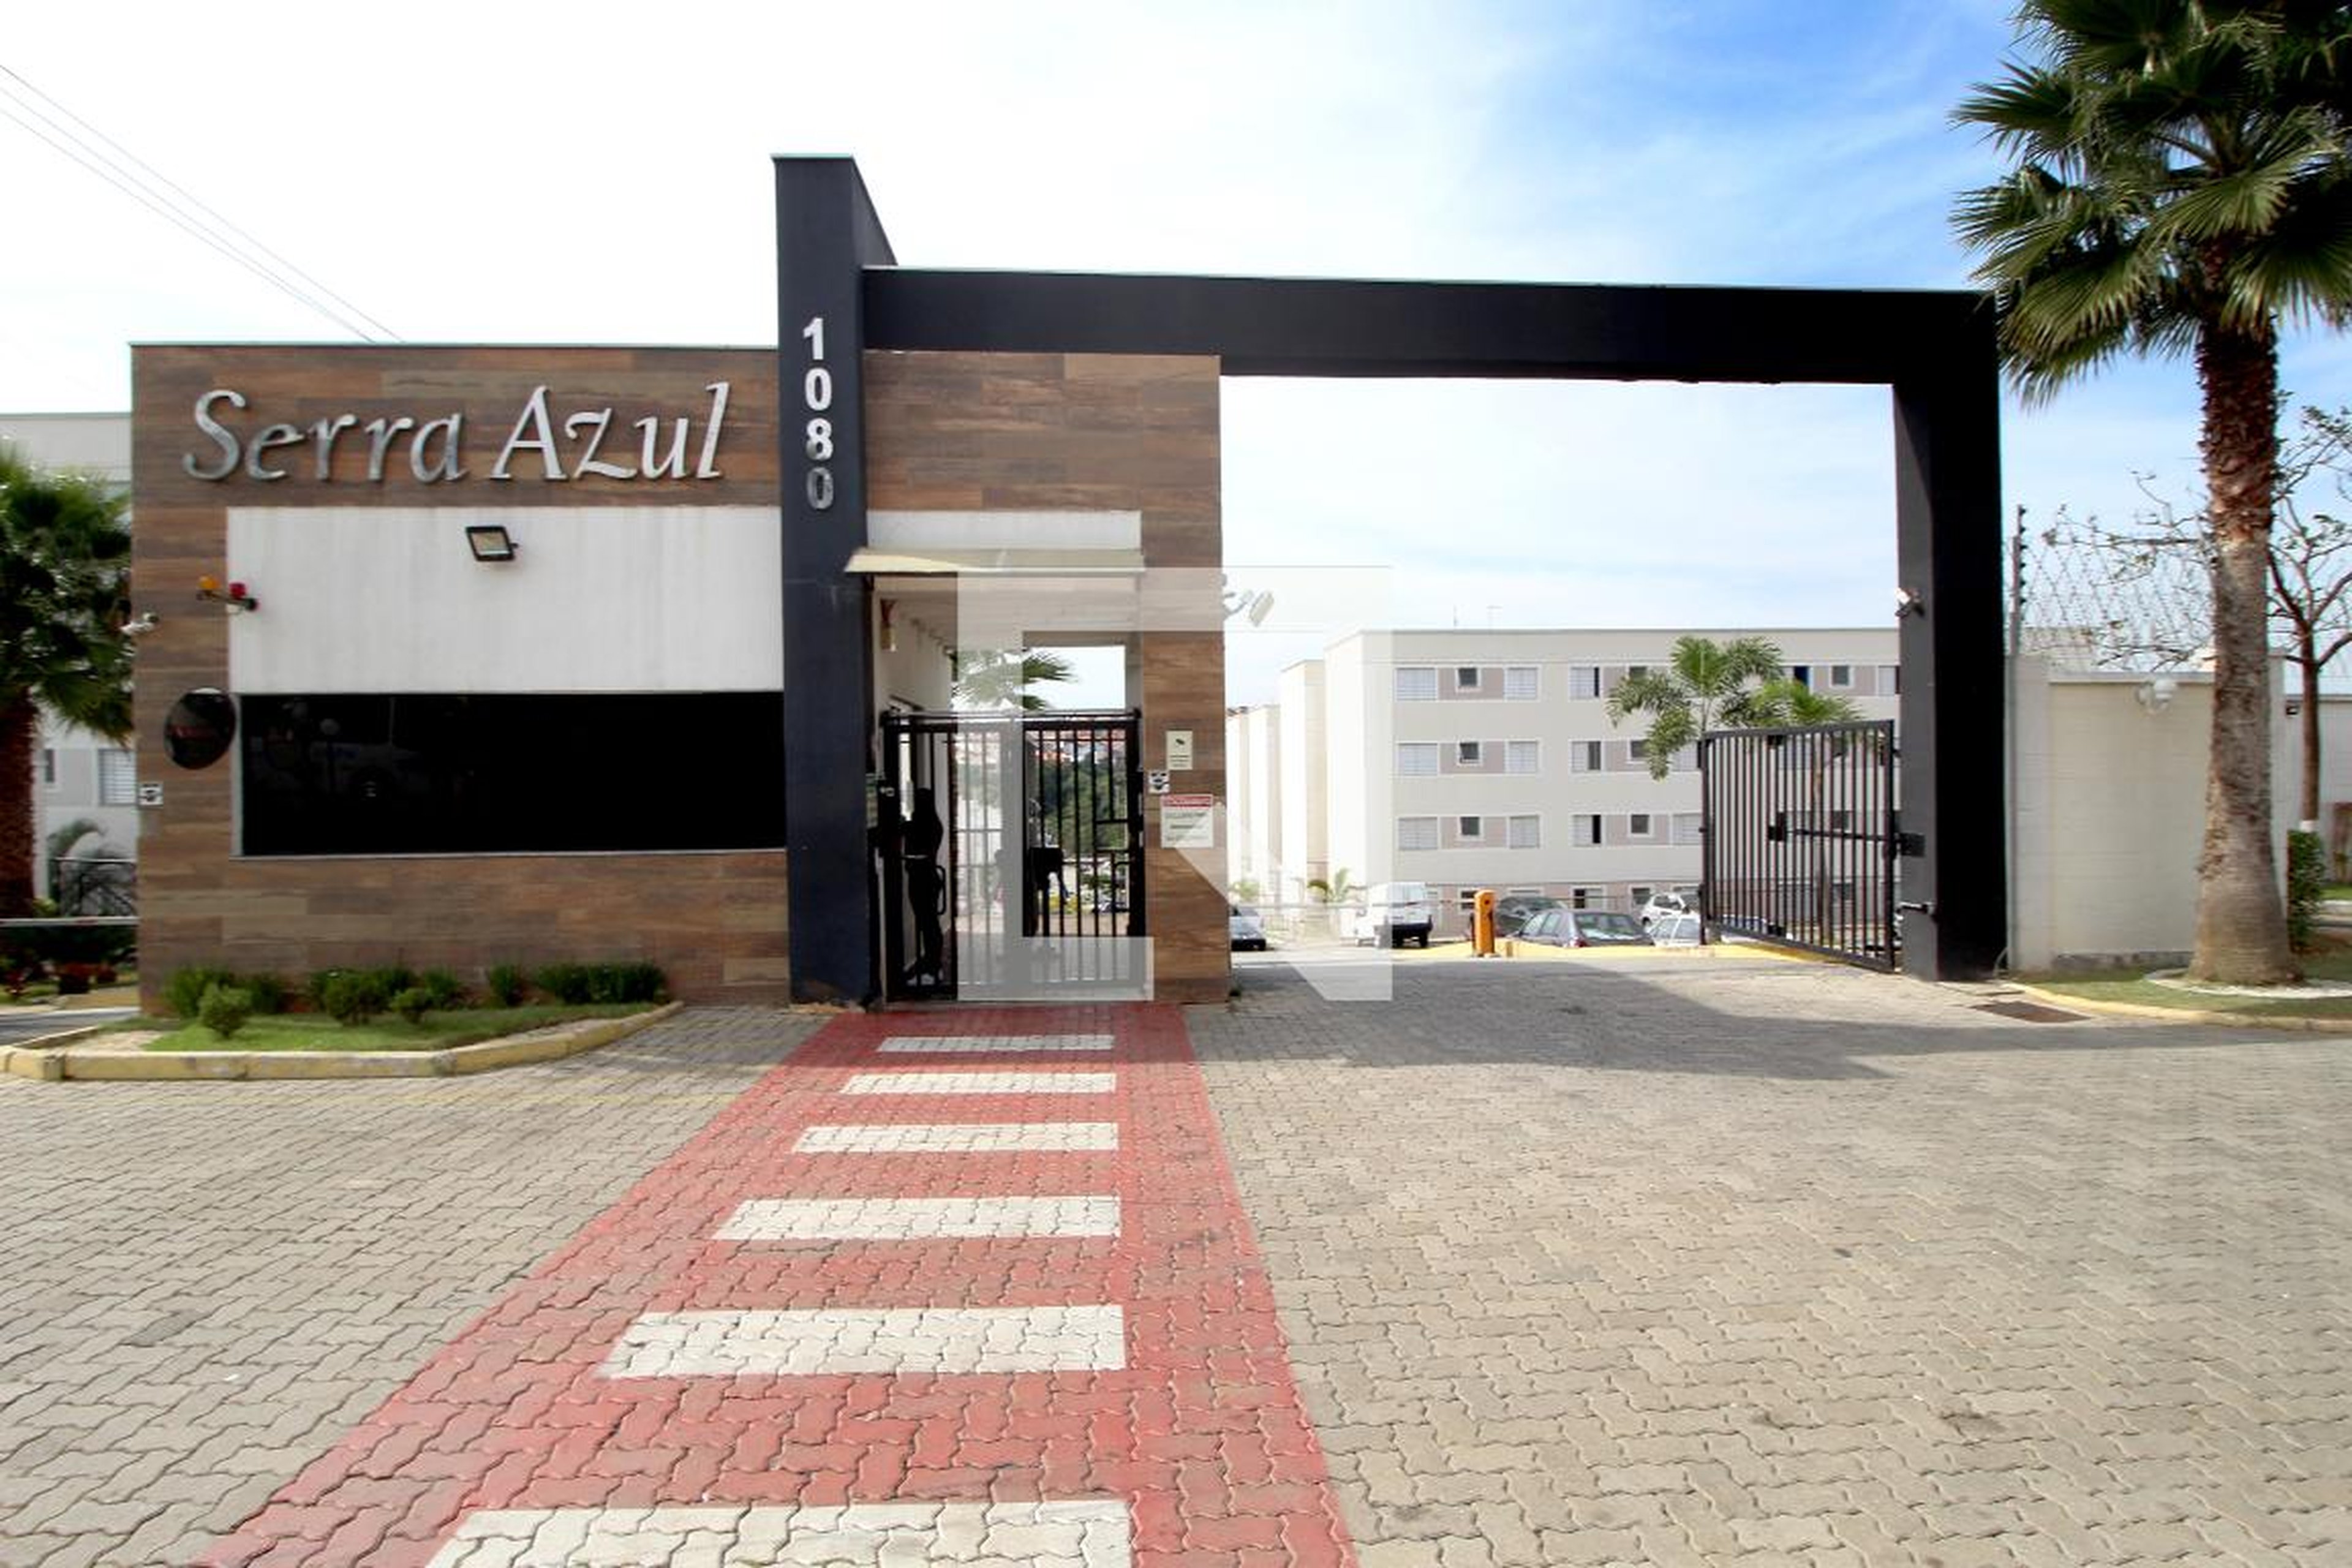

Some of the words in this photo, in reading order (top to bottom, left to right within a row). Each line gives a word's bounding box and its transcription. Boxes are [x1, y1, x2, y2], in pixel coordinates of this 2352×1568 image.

[183, 389, 470, 484] Serra
[487, 381, 730, 480] Azul
[803, 317, 834, 509] 1080
